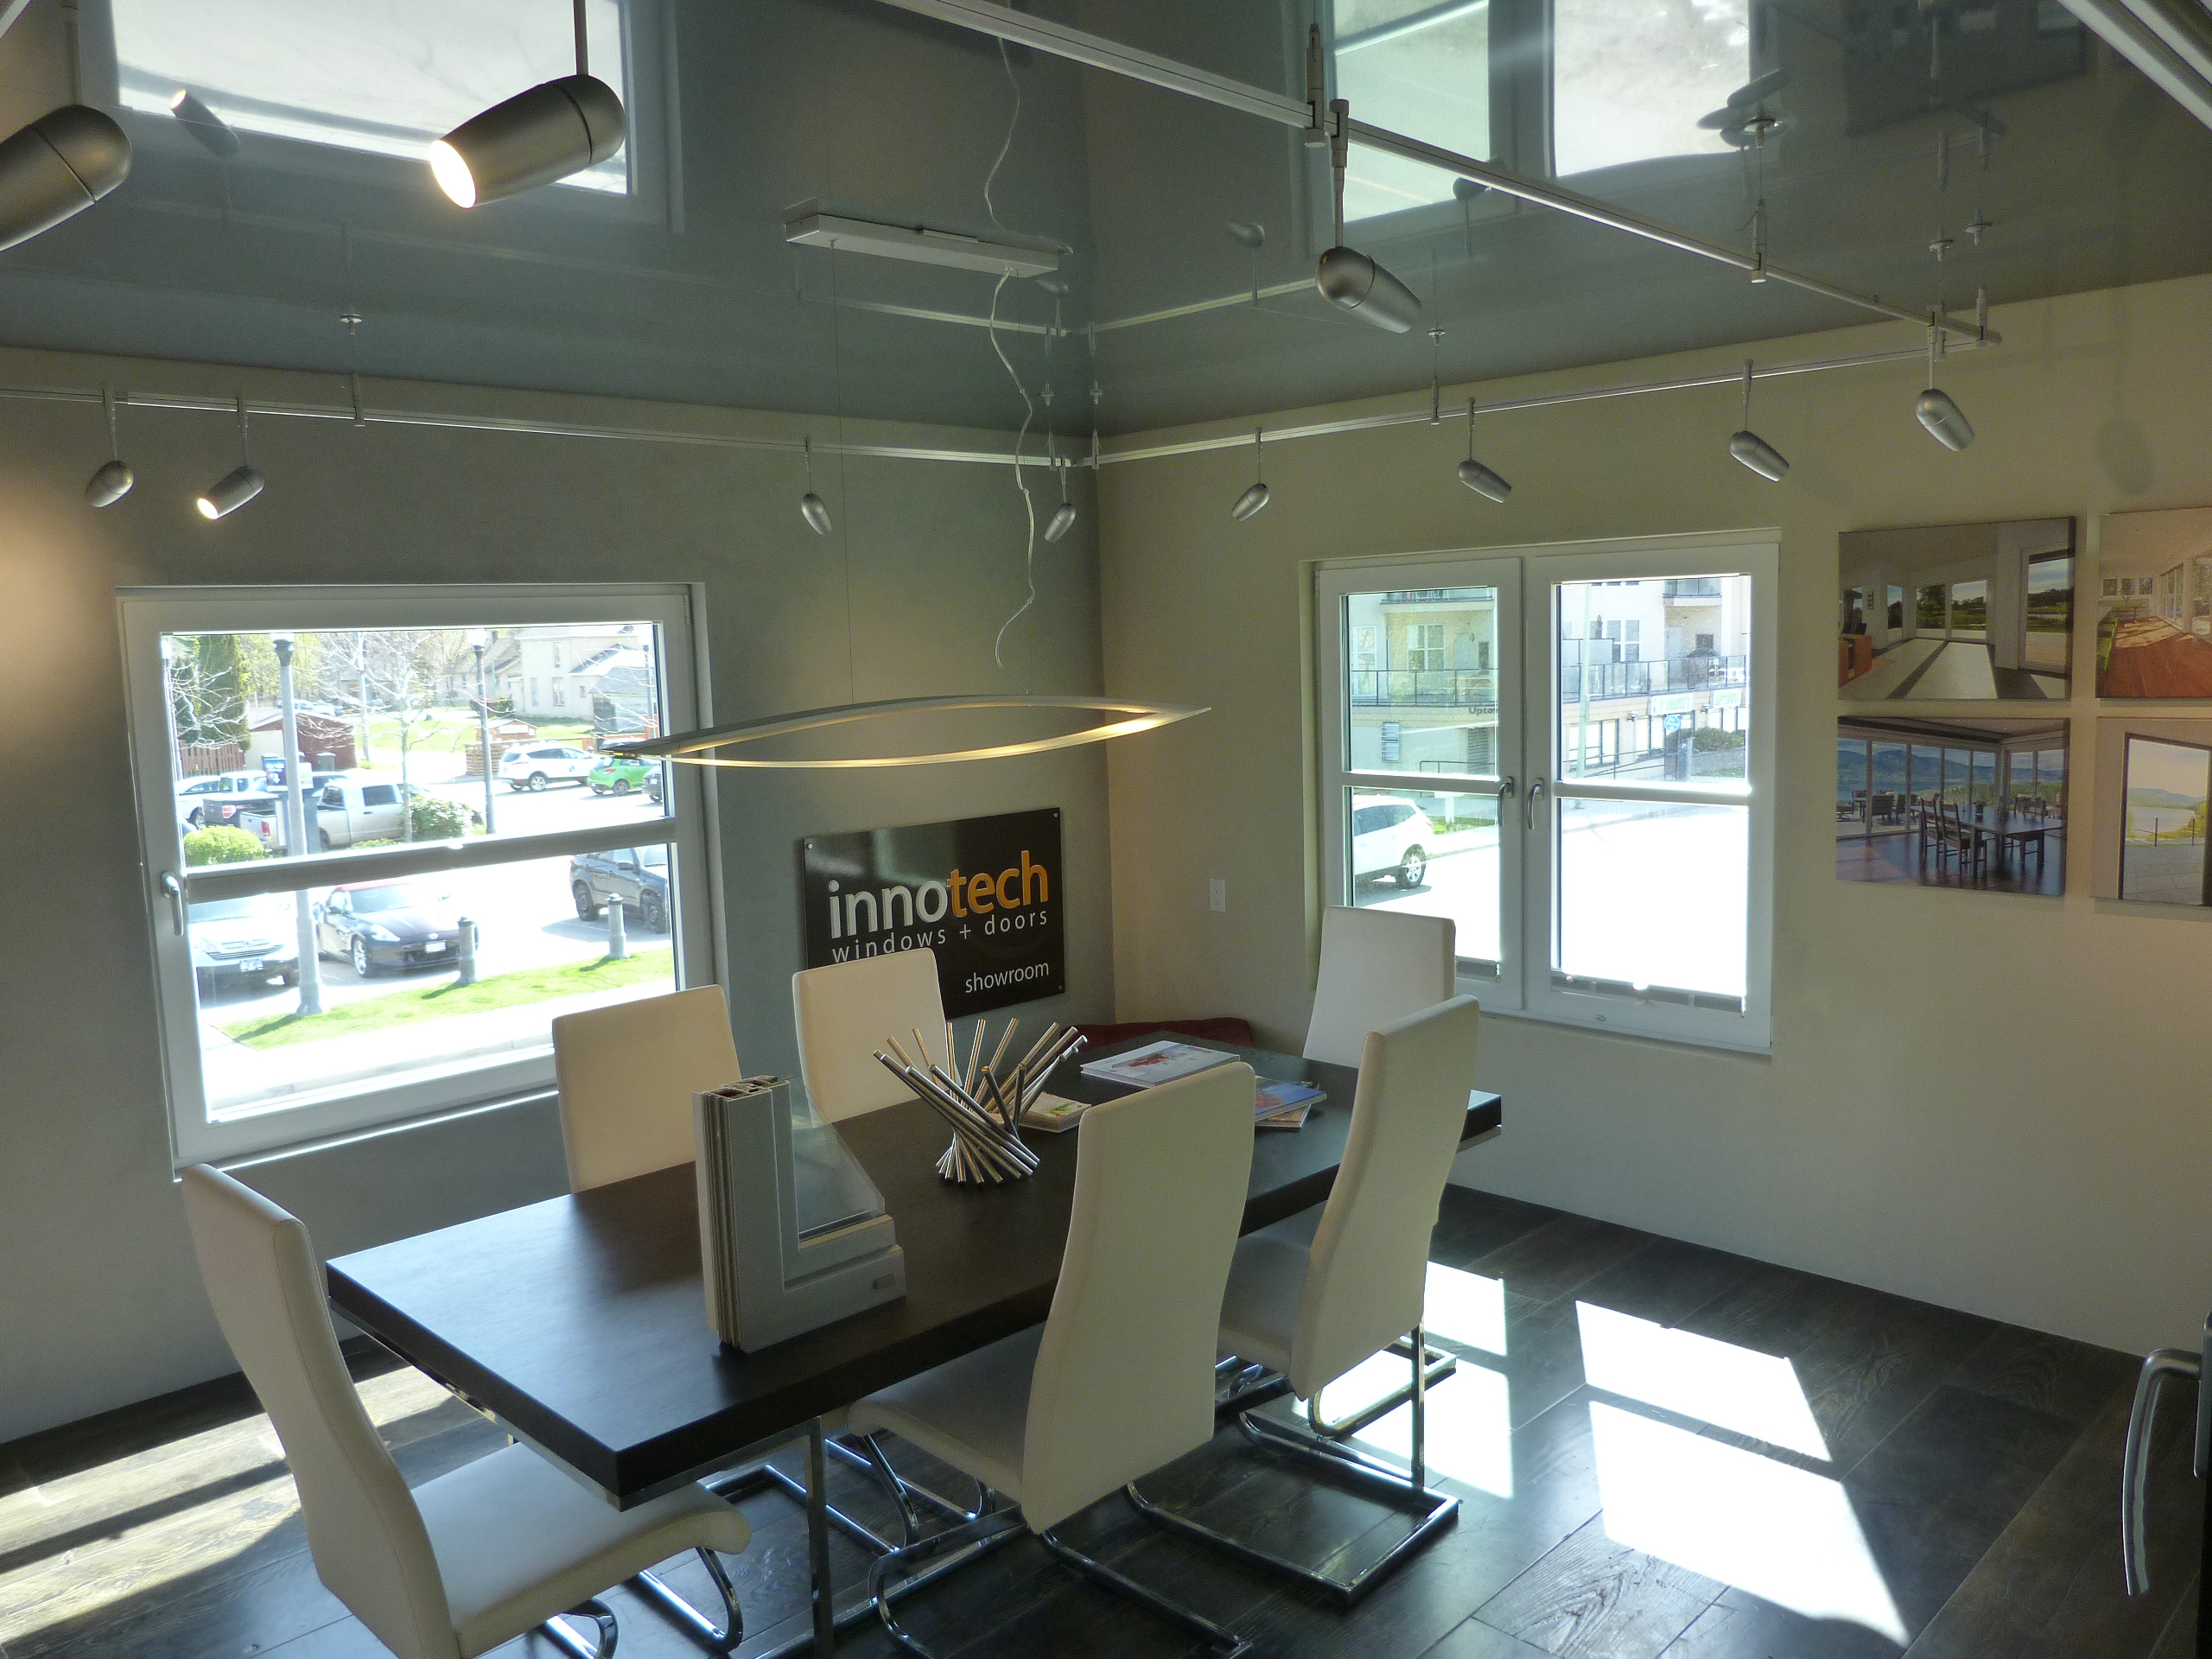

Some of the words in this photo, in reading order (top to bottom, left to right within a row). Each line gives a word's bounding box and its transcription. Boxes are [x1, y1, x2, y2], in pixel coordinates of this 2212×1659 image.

[830, 850, 1048, 938] innotech
[832, 929, 946, 963] windows
[959, 924, 971, 939] +
[984, 911, 1047, 936] doors
[965, 962, 1049, 994] showroom
